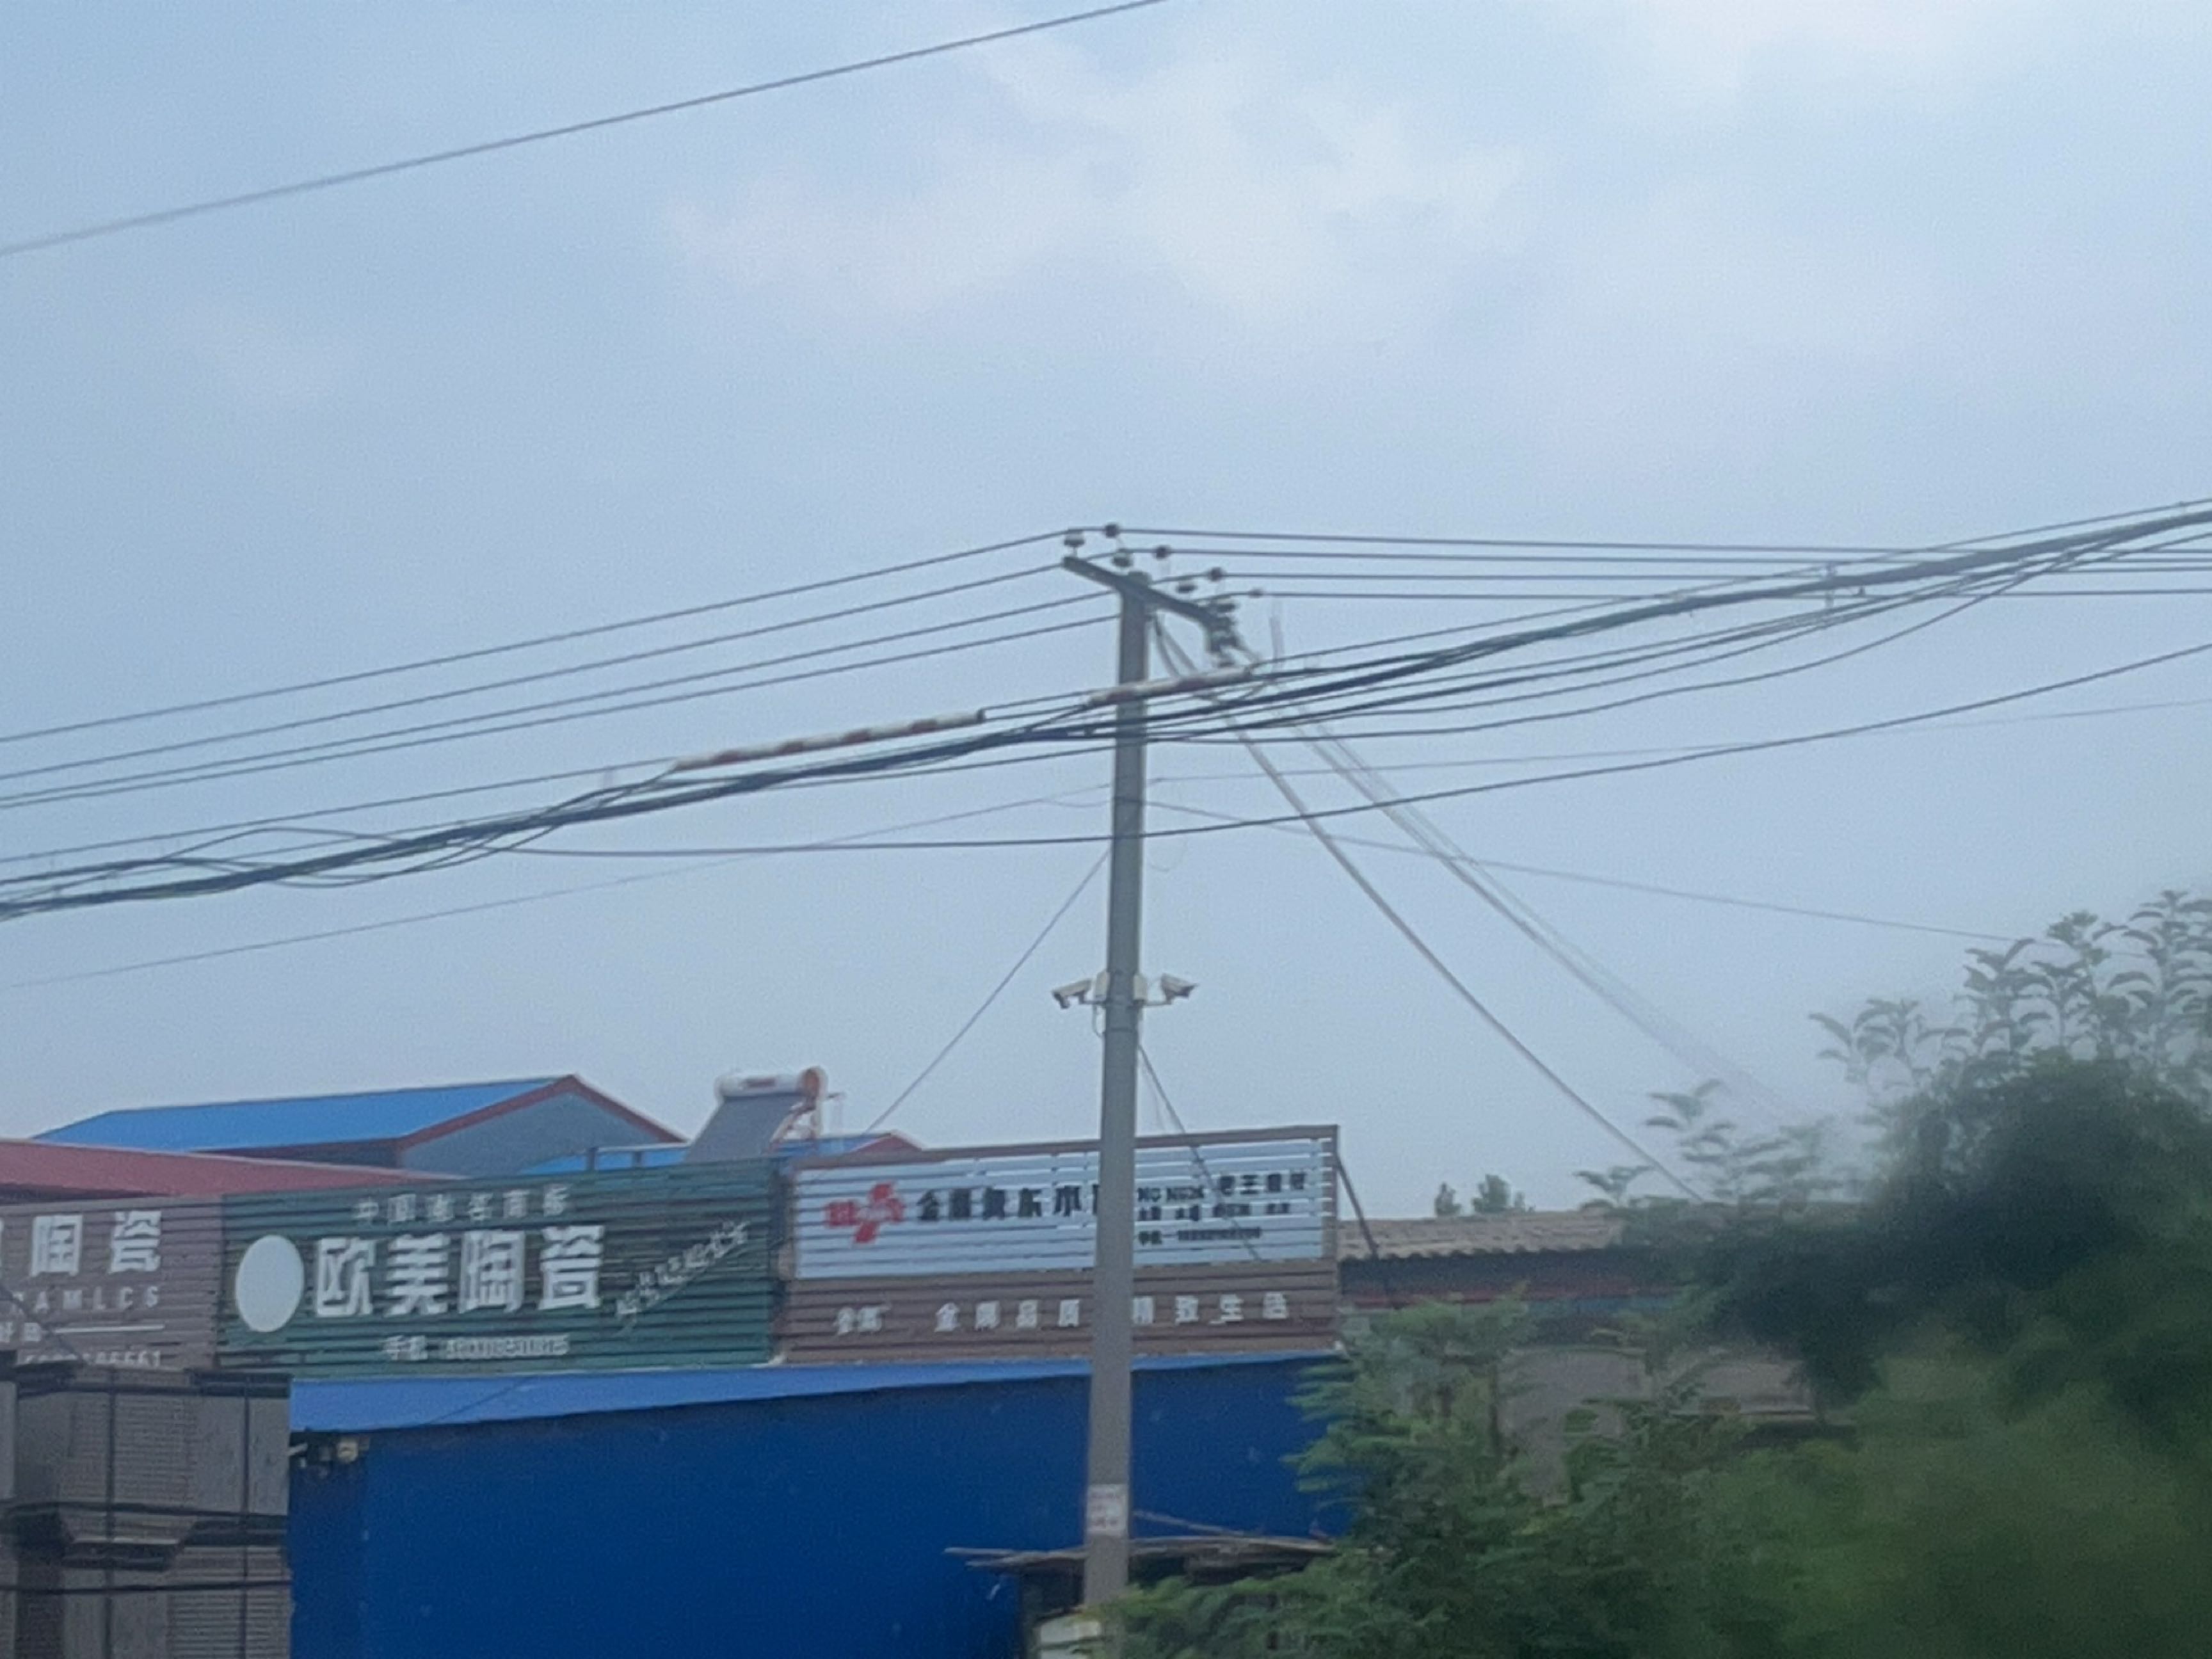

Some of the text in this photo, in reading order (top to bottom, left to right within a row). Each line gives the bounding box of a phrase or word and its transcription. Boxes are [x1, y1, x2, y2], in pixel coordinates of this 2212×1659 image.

[0, 1210, 161, 1277] 陶瓷
[316, 1225, 604, 1317] 欧美陶瓷
